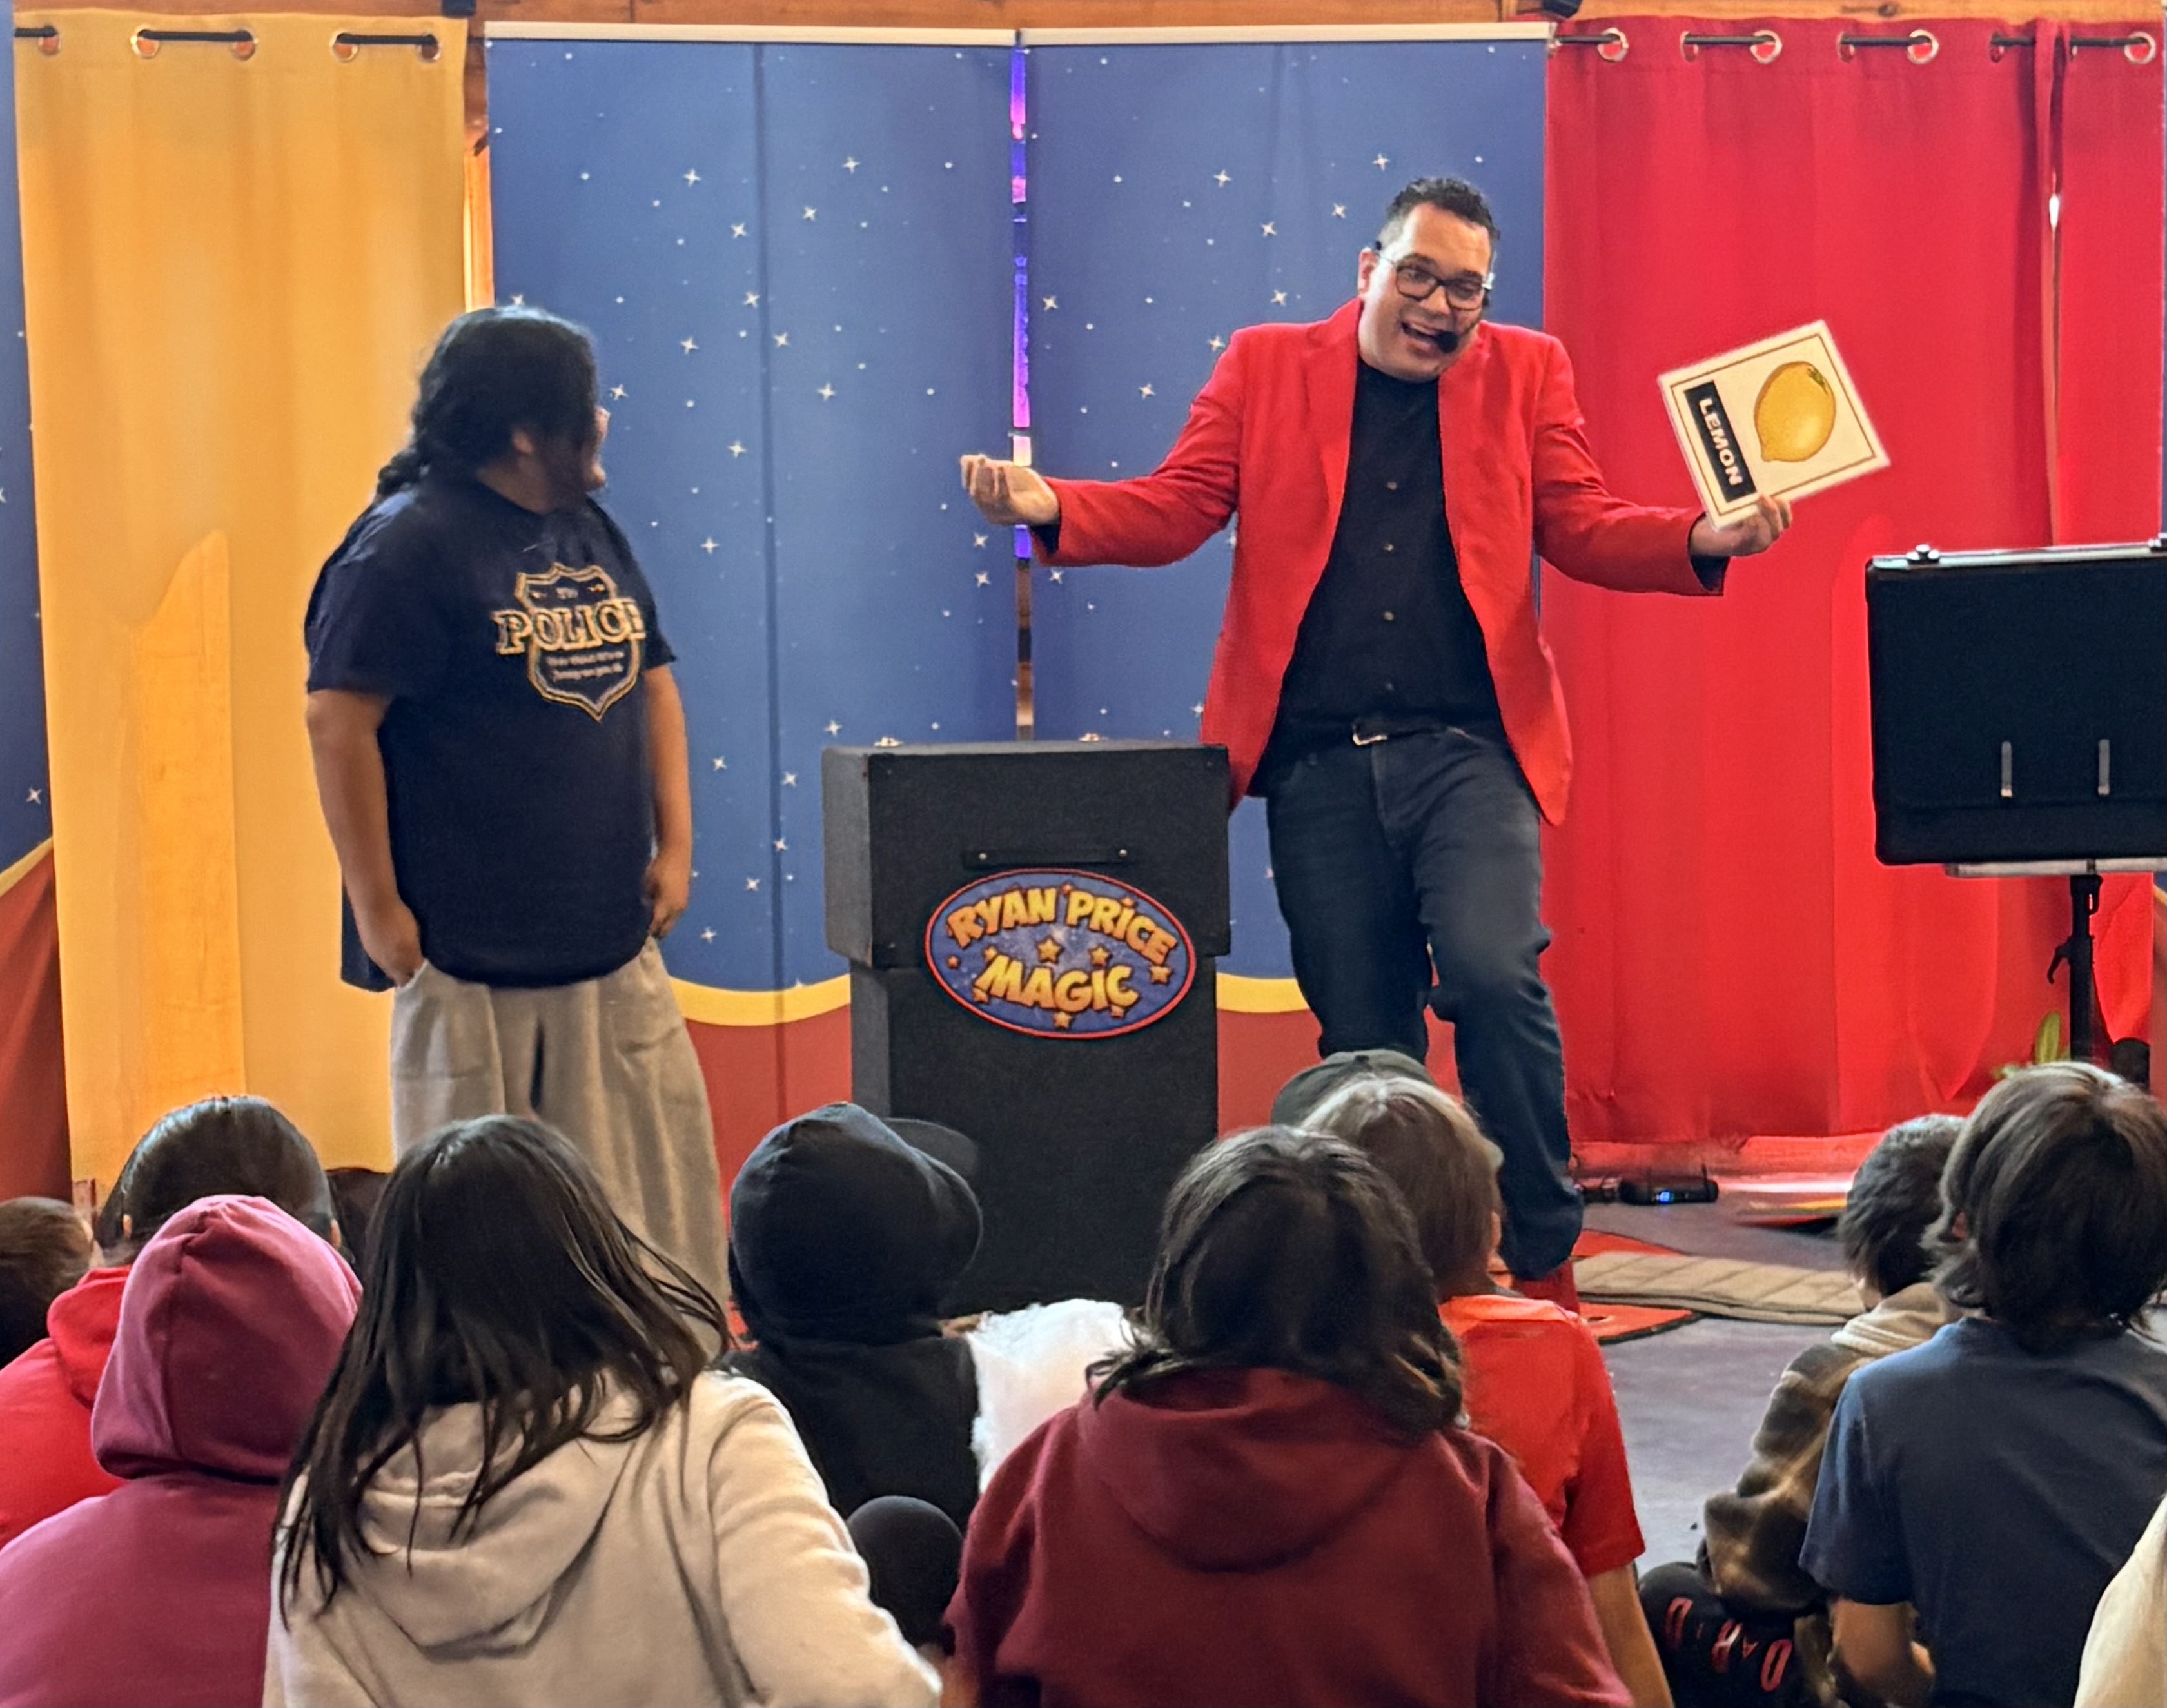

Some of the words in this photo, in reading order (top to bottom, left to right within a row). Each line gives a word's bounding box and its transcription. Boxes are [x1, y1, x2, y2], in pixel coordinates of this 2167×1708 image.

[1698, 398, 1743, 486] LEMON
[946, 887, 1057, 948] RYAN
[1065, 889, 1179, 965] PRICE
[974, 954, 1139, 1014] MAGIC
